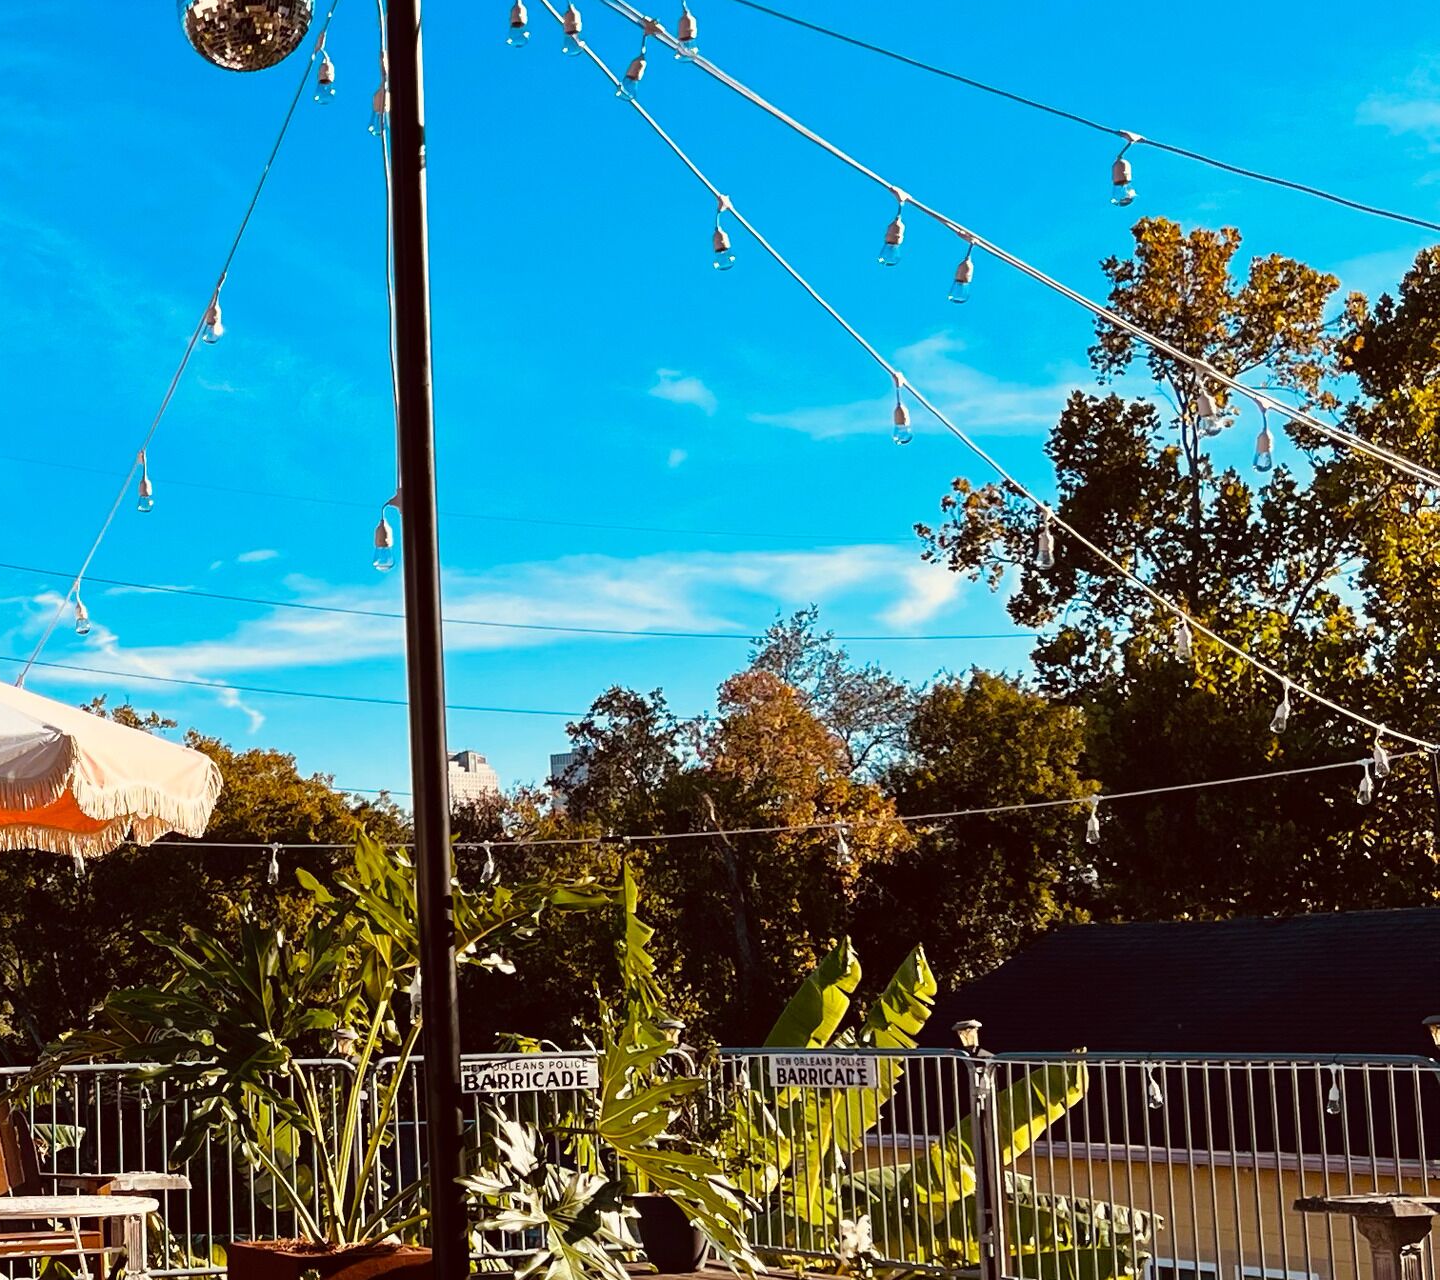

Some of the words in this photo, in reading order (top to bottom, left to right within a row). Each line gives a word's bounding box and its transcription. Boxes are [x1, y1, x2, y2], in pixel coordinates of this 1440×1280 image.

[548, 1060, 588, 1070] POLICE
[775, 1057, 792, 1066] NEW
[793, 1057, 832, 1067] ORLEANS
[835, 1057, 866, 1067] POLICE
[464, 1070, 589, 1091] BARRICADE
[776, 1067, 868, 1086] BARRICADE
